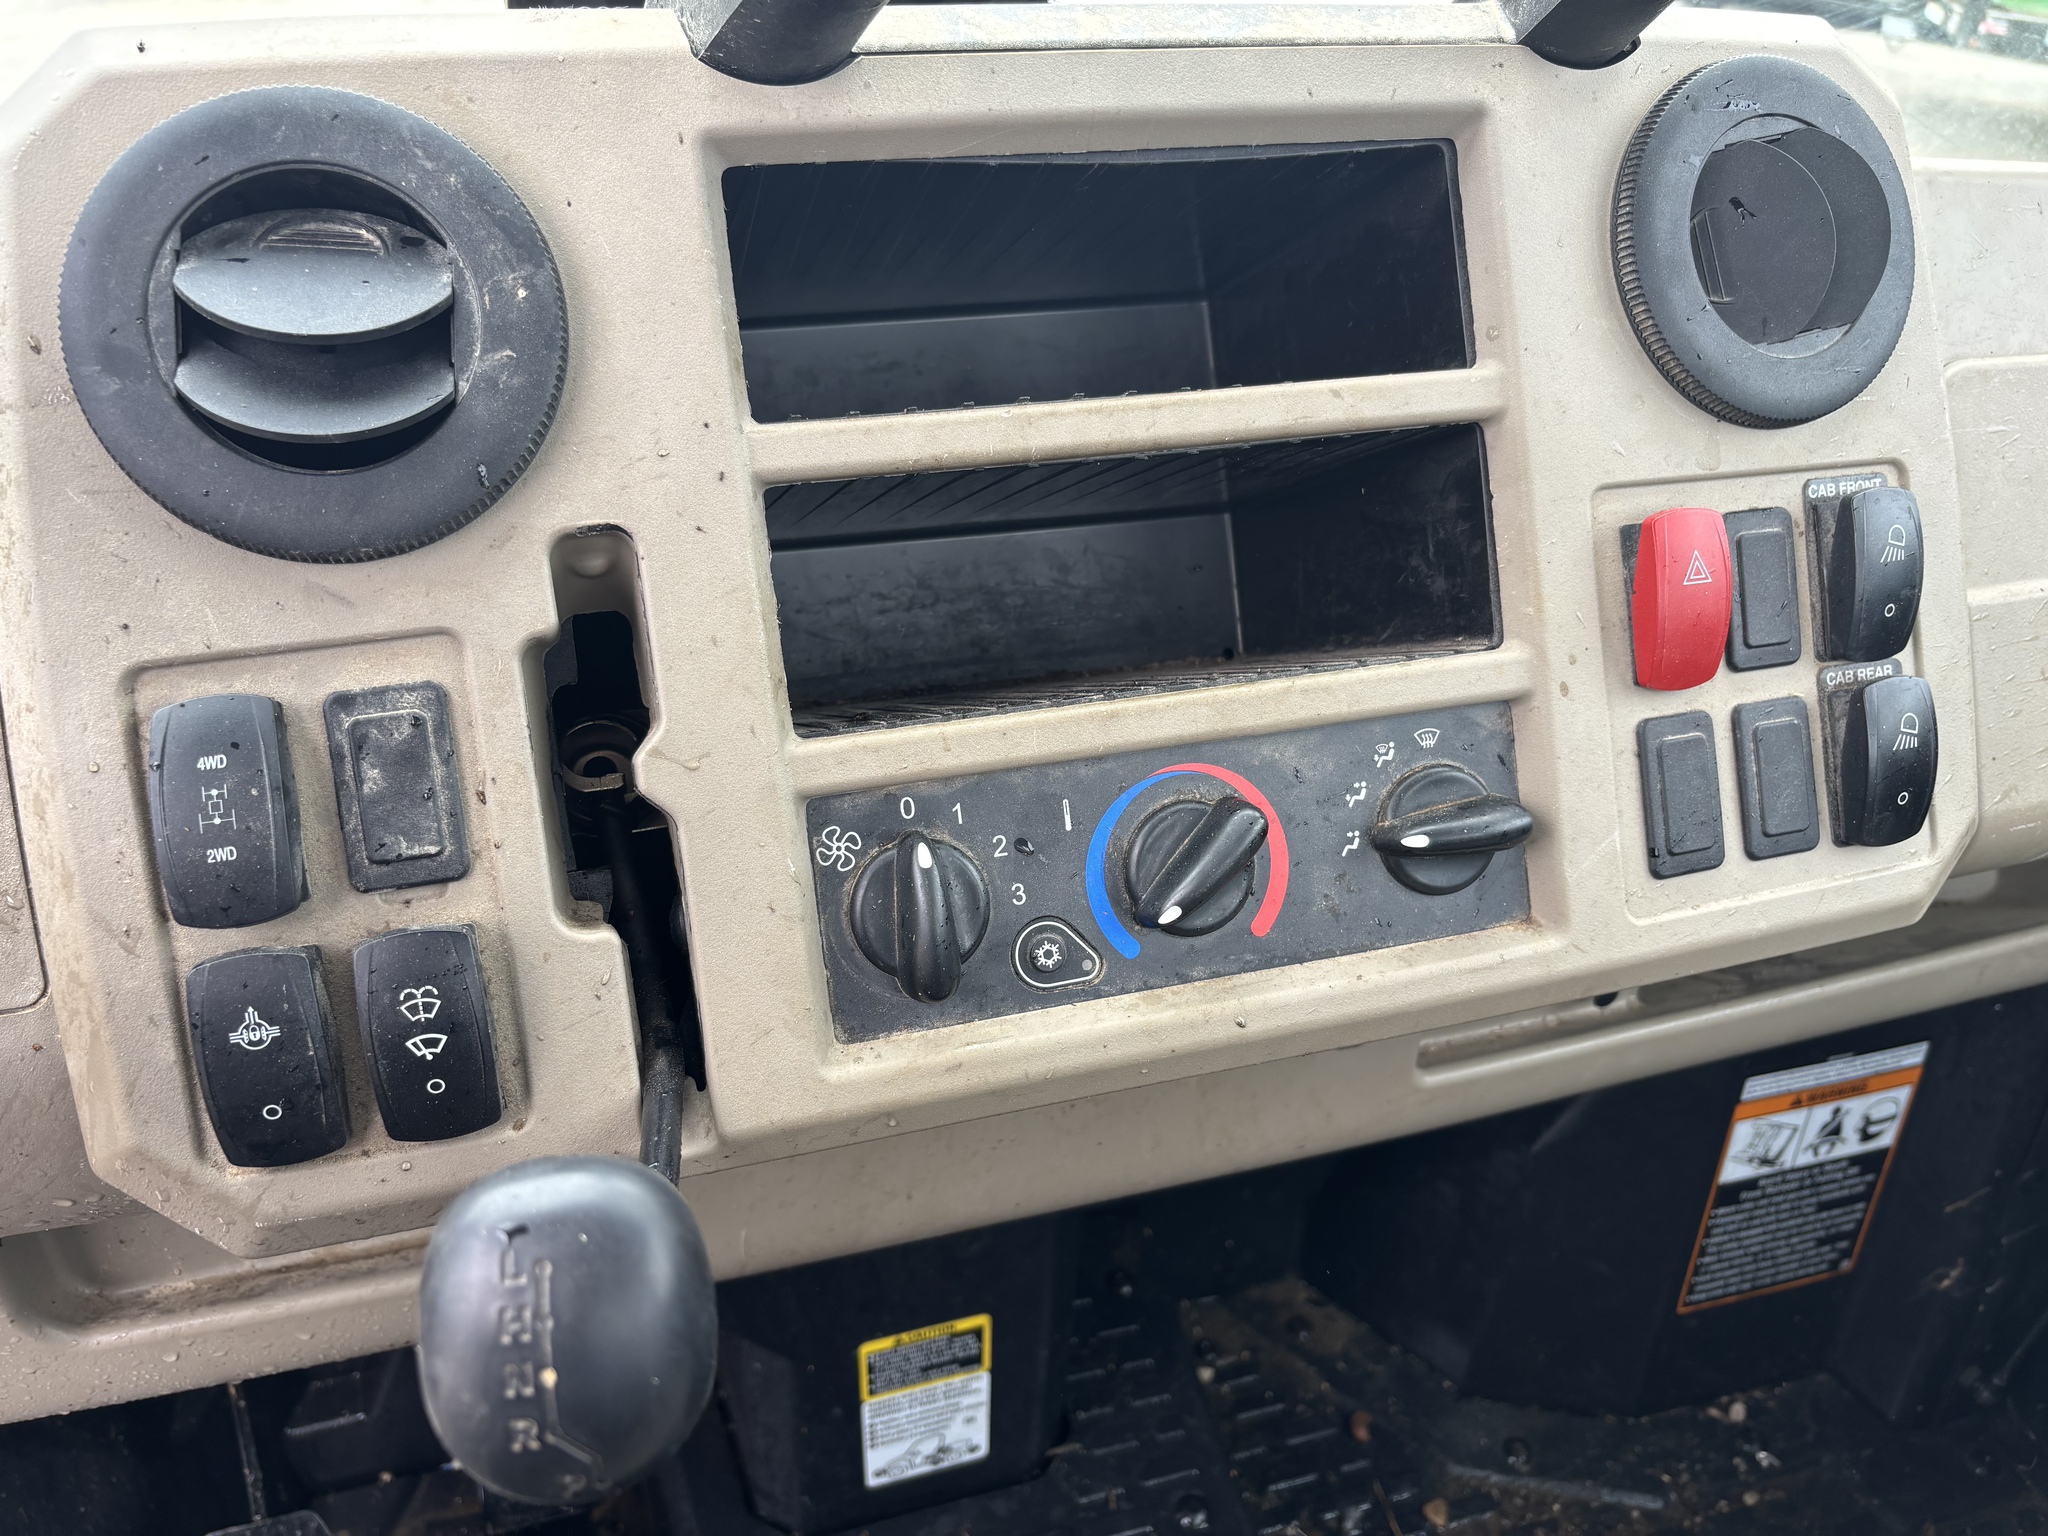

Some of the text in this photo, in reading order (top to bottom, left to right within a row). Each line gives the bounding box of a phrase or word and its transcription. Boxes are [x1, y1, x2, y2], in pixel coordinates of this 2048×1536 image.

[1808, 482, 1832, 499] CAB
[1826, 664, 1893, 686] CAB REAR
[196, 754, 228, 771] 4WD
[900, 796, 916, 820] 0
[951, 802, 964, 825] 1
[206, 846, 238, 864] 2WD
[992, 834, 1009, 858] 2
[1011, 883, 1027, 906] 3
[502, 1248, 528, 1287] L
[499, 1303, 533, 1346] H
[503, 1360, 535, 1400] N
[508, 1416, 543, 1453] R
